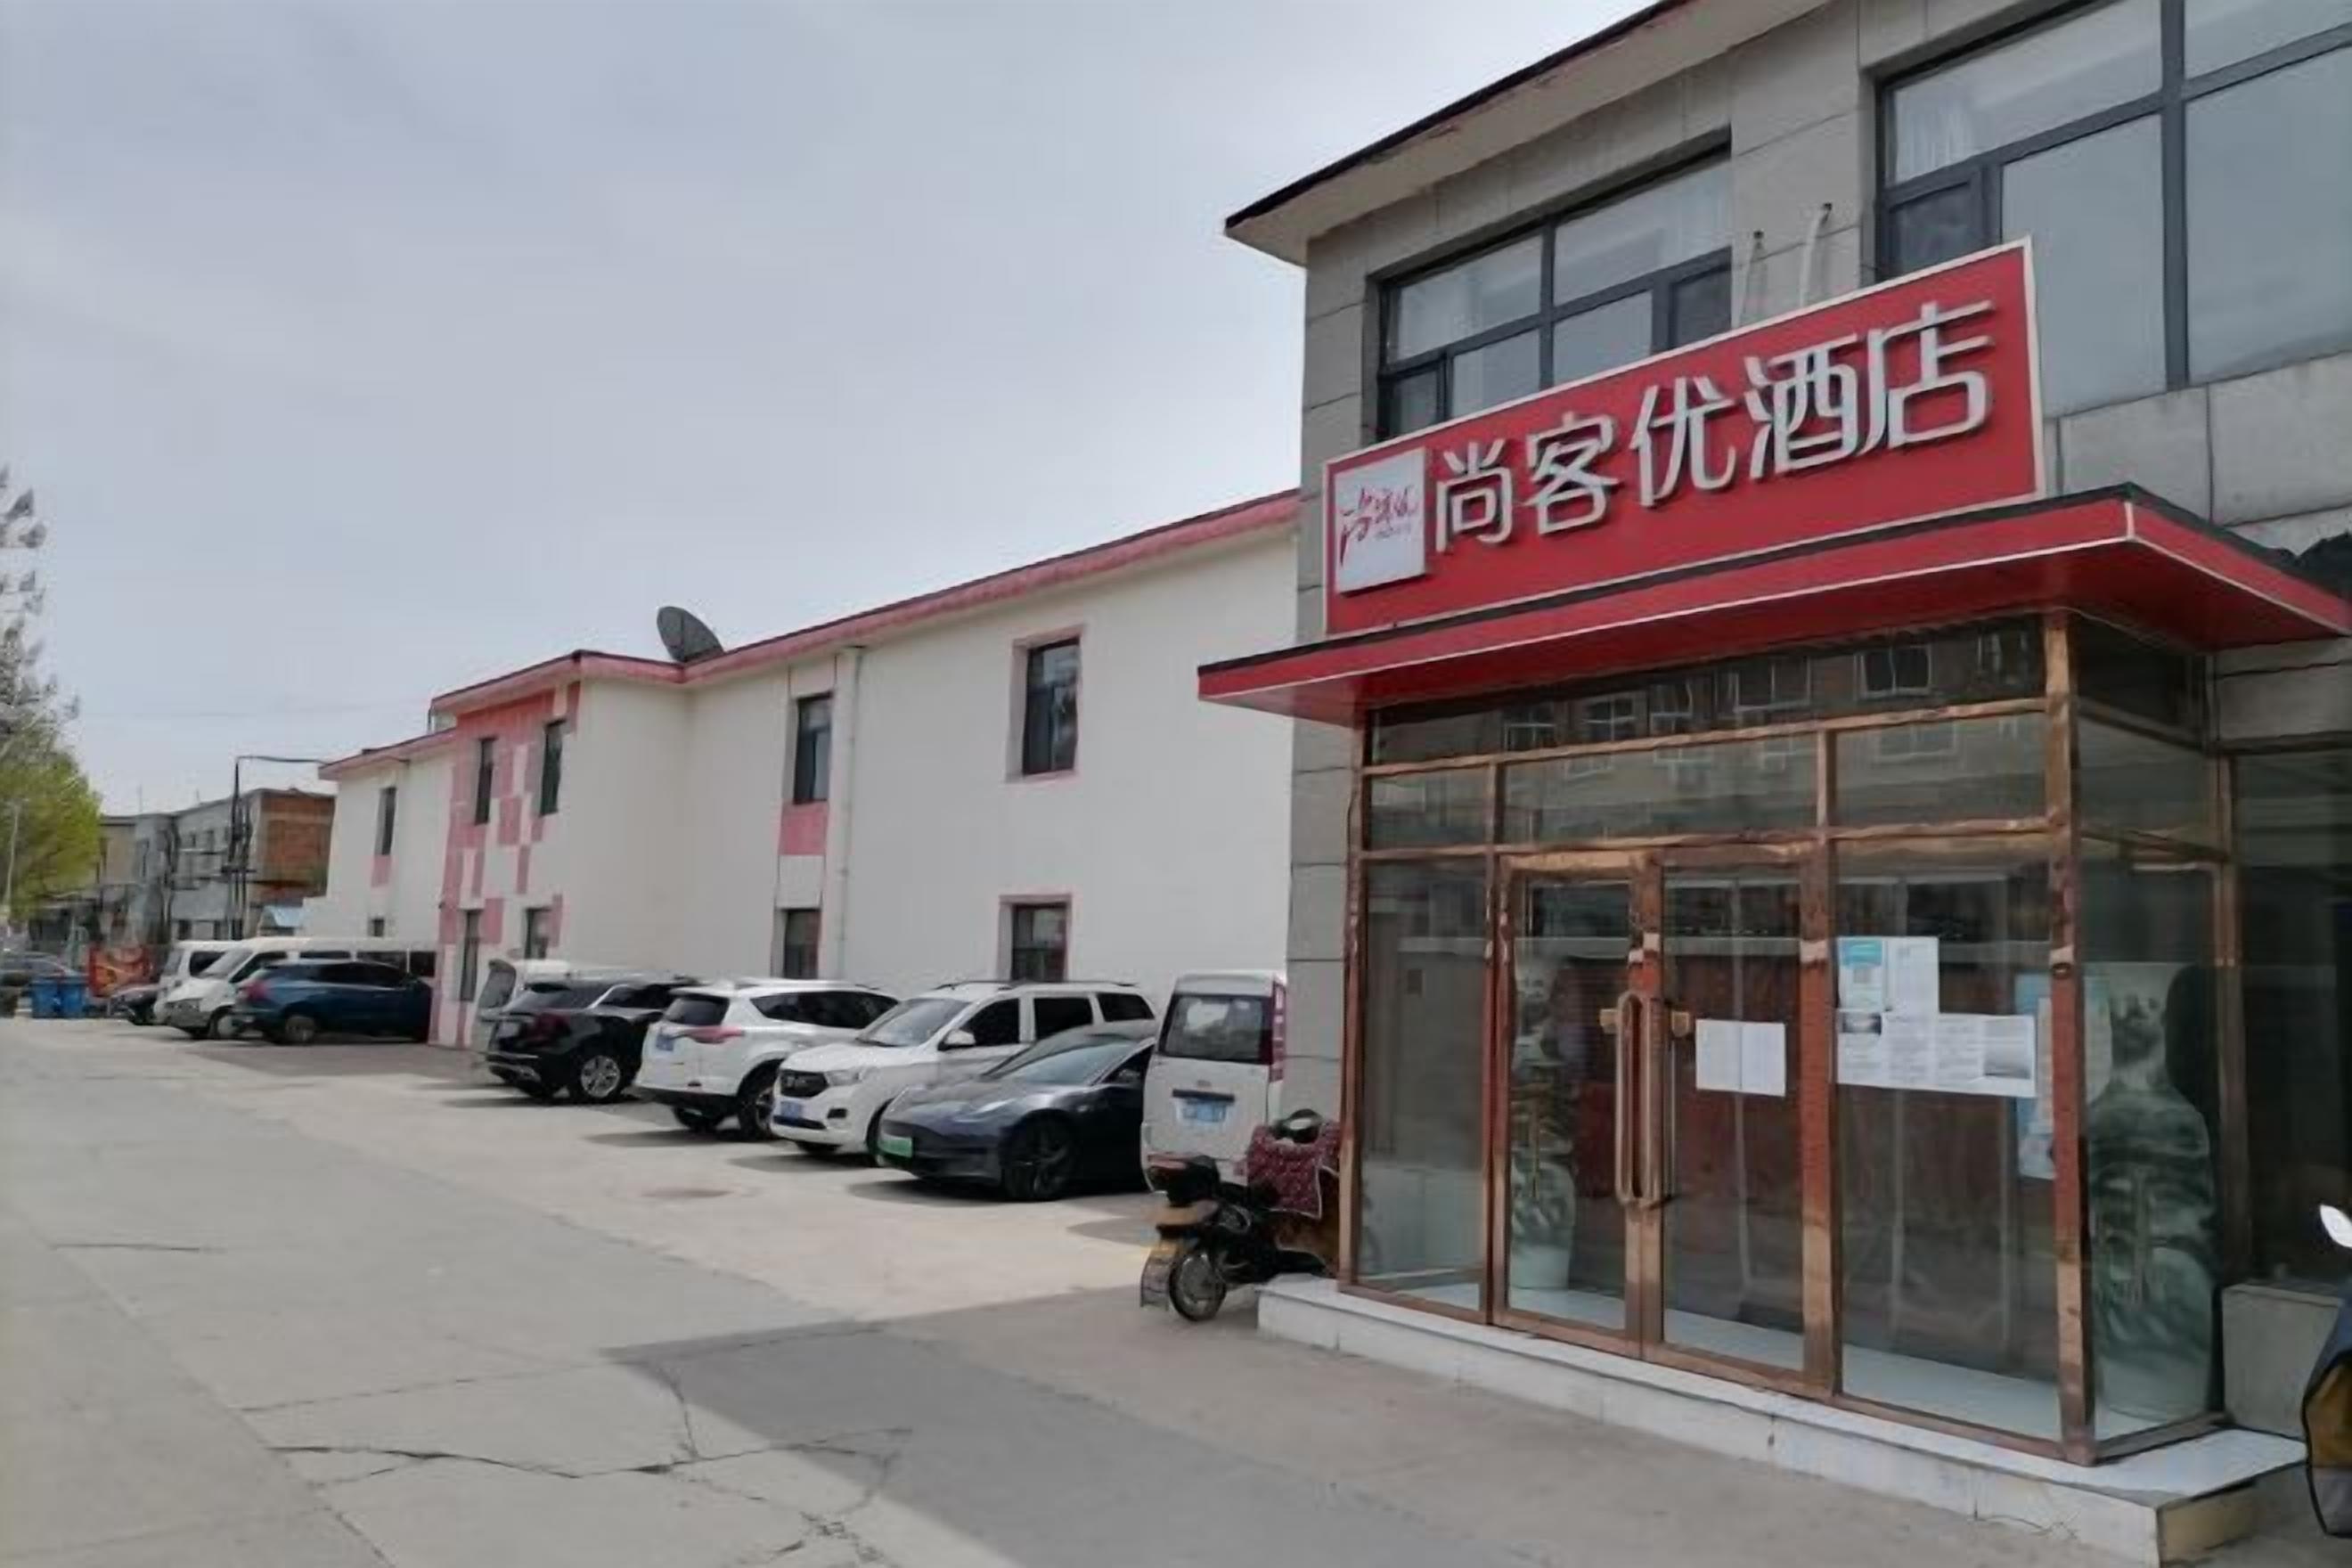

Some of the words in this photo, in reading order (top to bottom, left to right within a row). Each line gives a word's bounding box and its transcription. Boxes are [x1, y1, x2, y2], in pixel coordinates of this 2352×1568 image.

[1435, 301, 1995, 552] 尚客优酒店
